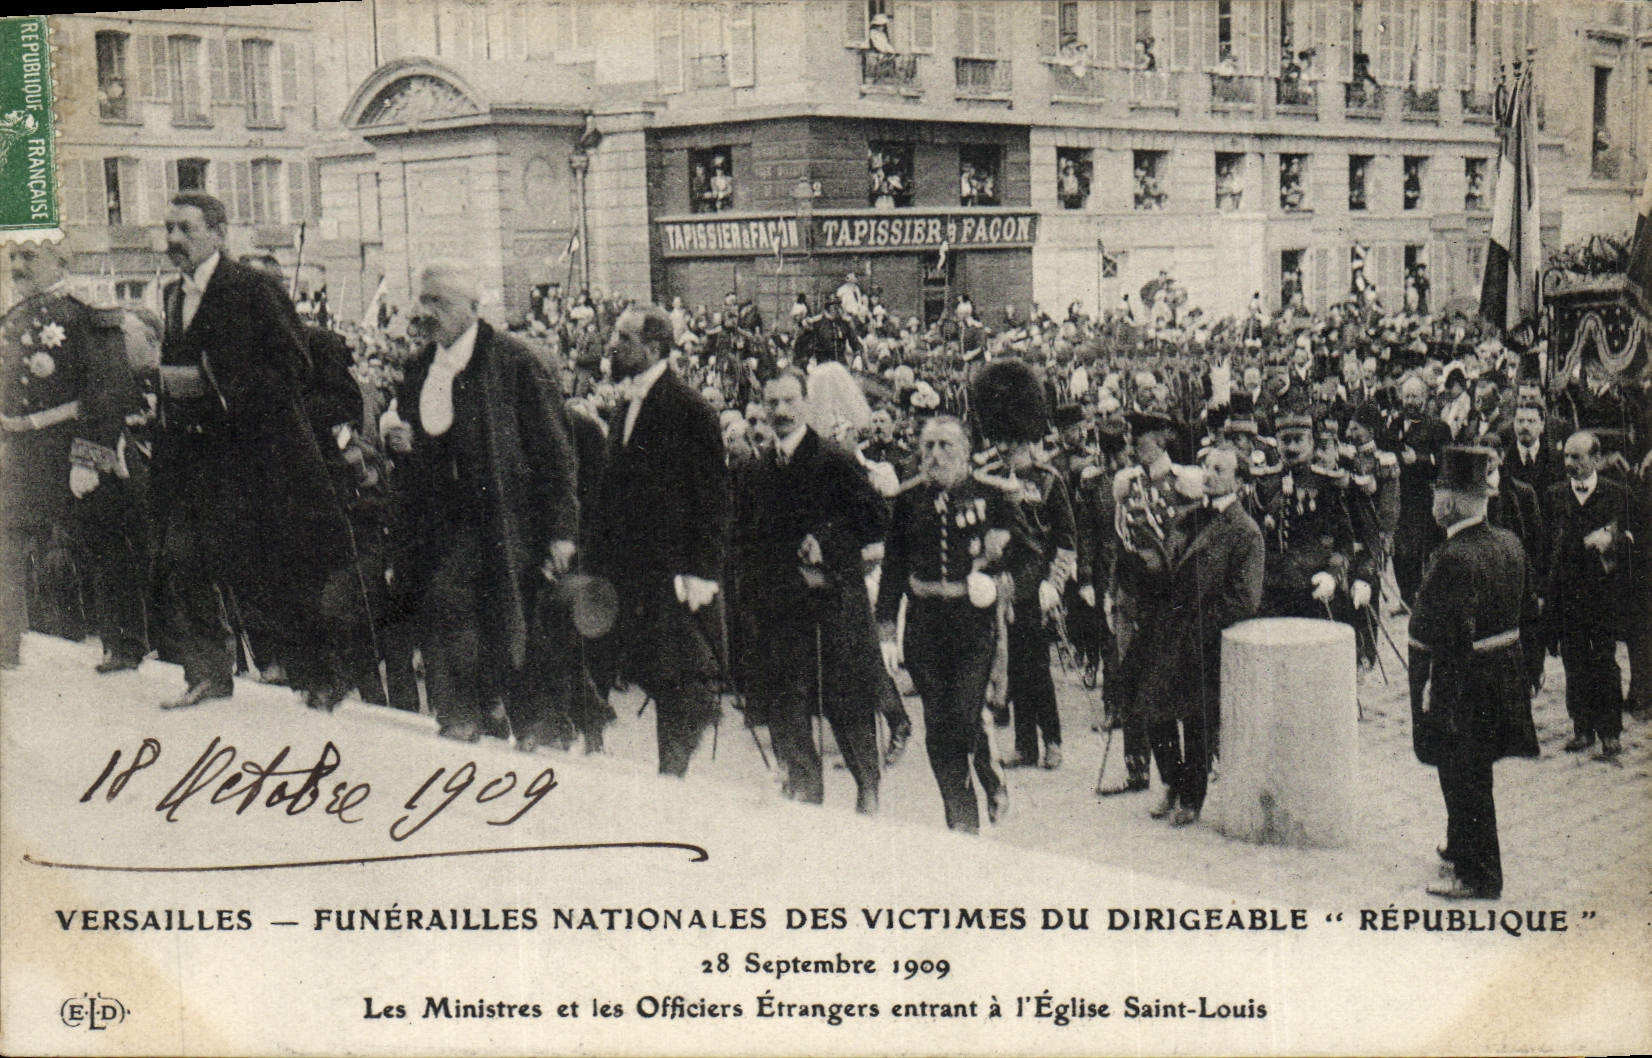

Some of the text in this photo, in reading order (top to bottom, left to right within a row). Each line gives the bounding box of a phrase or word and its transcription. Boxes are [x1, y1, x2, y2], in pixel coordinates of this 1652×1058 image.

[27, 138, 49, 220] FRANÇAISE
[665, 222, 741, 251] TAPISSIER
[822, 218, 942, 247] TAPISSIER
[961, 216, 1032, 244] FAÇON
[80, 735, 558, 842] 18 Octobre 1909
